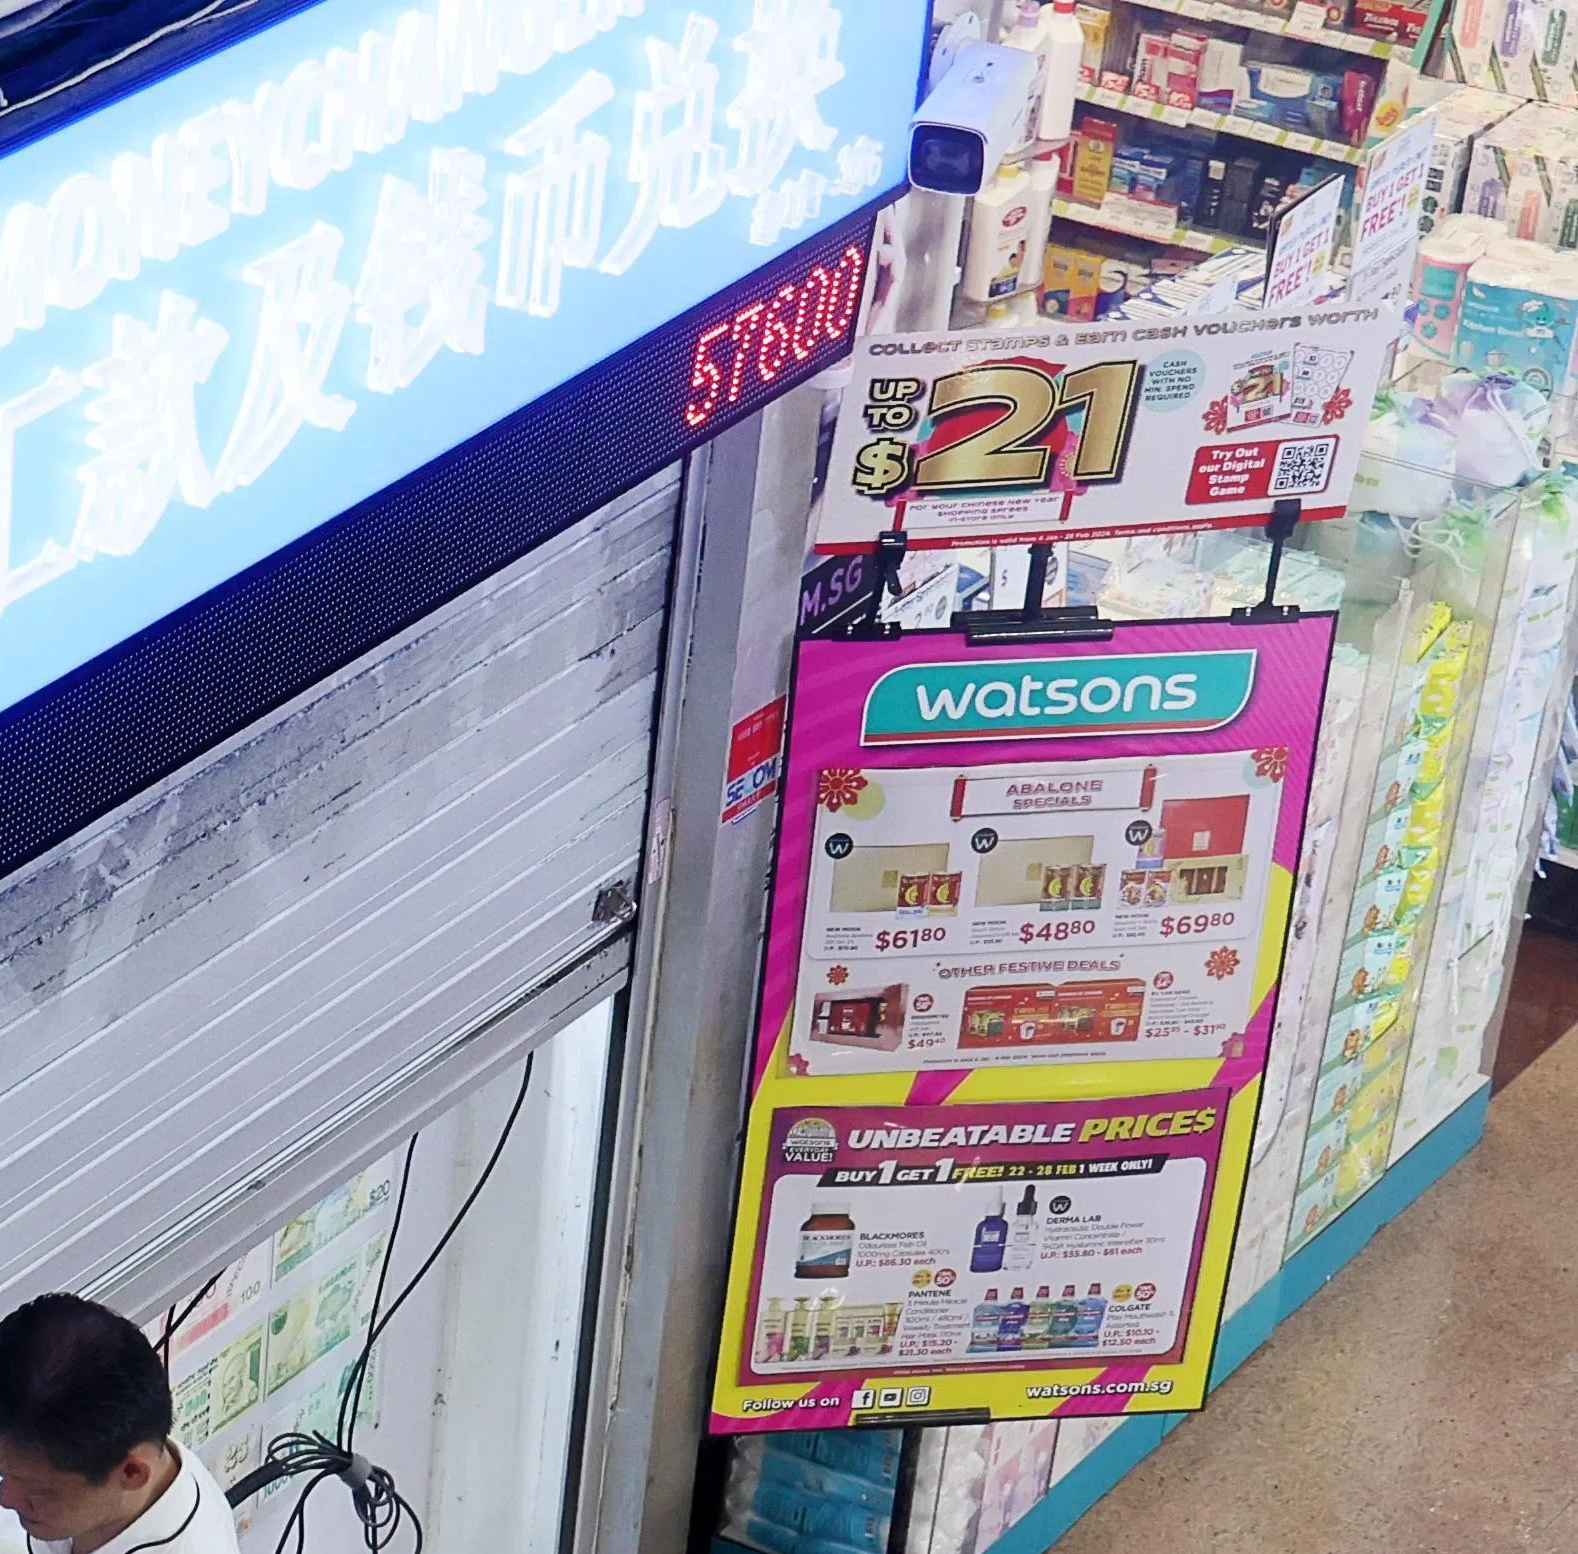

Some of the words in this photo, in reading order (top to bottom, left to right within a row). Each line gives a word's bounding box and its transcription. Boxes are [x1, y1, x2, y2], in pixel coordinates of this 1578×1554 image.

[1055, 334, 1070, 348] &
[1149, 367, 1198, 377] VOUCHERS
[1152, 377, 1176, 385] WITH
[869, 378, 921, 402] UP
[866, 404, 915, 430] TO
[1211, 448, 1234, 461] Try
[1235, 447, 1259, 458] Out
[1198, 463, 1221, 473] our
[1223, 457, 1266, 472] Digital
[1208, 473, 1250, 485] Stamp
[1209, 486, 1246, 497] Game
[916, 673, 1199, 722] watsons
[725, 755, 777, 807] SECOM
[1006, 780, 1104, 797] ABALONE
[1012, 795, 1092, 810] SPECIALS
[938, 965, 995, 979] OTHER
[999, 959, 1065, 975] FESTIVE
[1067, 960, 1121, 972] DEALS
[847, 1122, 1076, 1150] UNBEATABLE
[785, 1151, 834, 1163] VALUE!
[834, 1168, 877, 1183] BUY
[875, 1159, 898, 1184] 1
[896, 1168, 935, 1182] GET
[931, 1157, 954, 1182] 1
[951, 1165, 1004, 1181] FREE!
[1009, 1165, 1025, 1176] 22
[1036, 1164, 1052, 1176] 28
[1054, 1163, 1077, 1175] FEB
[1078, 1162, 1085, 1174] 1
[1088, 1160, 1118, 1174] WEEK
[1120, 1158, 1153, 1171] ONLY!
[1045, 1216, 1080, 1225] DERMA
[1082, 1214, 1102, 1223] LAB
[859, 1231, 925, 1241] BLACKMORES
[1120, 1246, 1143, 1255] each
[913, 1257, 937, 1266] each
[908, 1289, 952, 1298] PANTENE
[1108, 1303, 1152, 1313] COLGATE
[1133, 1337, 1156, 1345] each
[930, 1347, 953, 1355] each
[1026, 1378, 1174, 1399] watsons.com.sg
[743, 1398, 793, 1412] Follow
[799, 1398, 816, 1408] us
[820, 1396, 840, 1406] on
